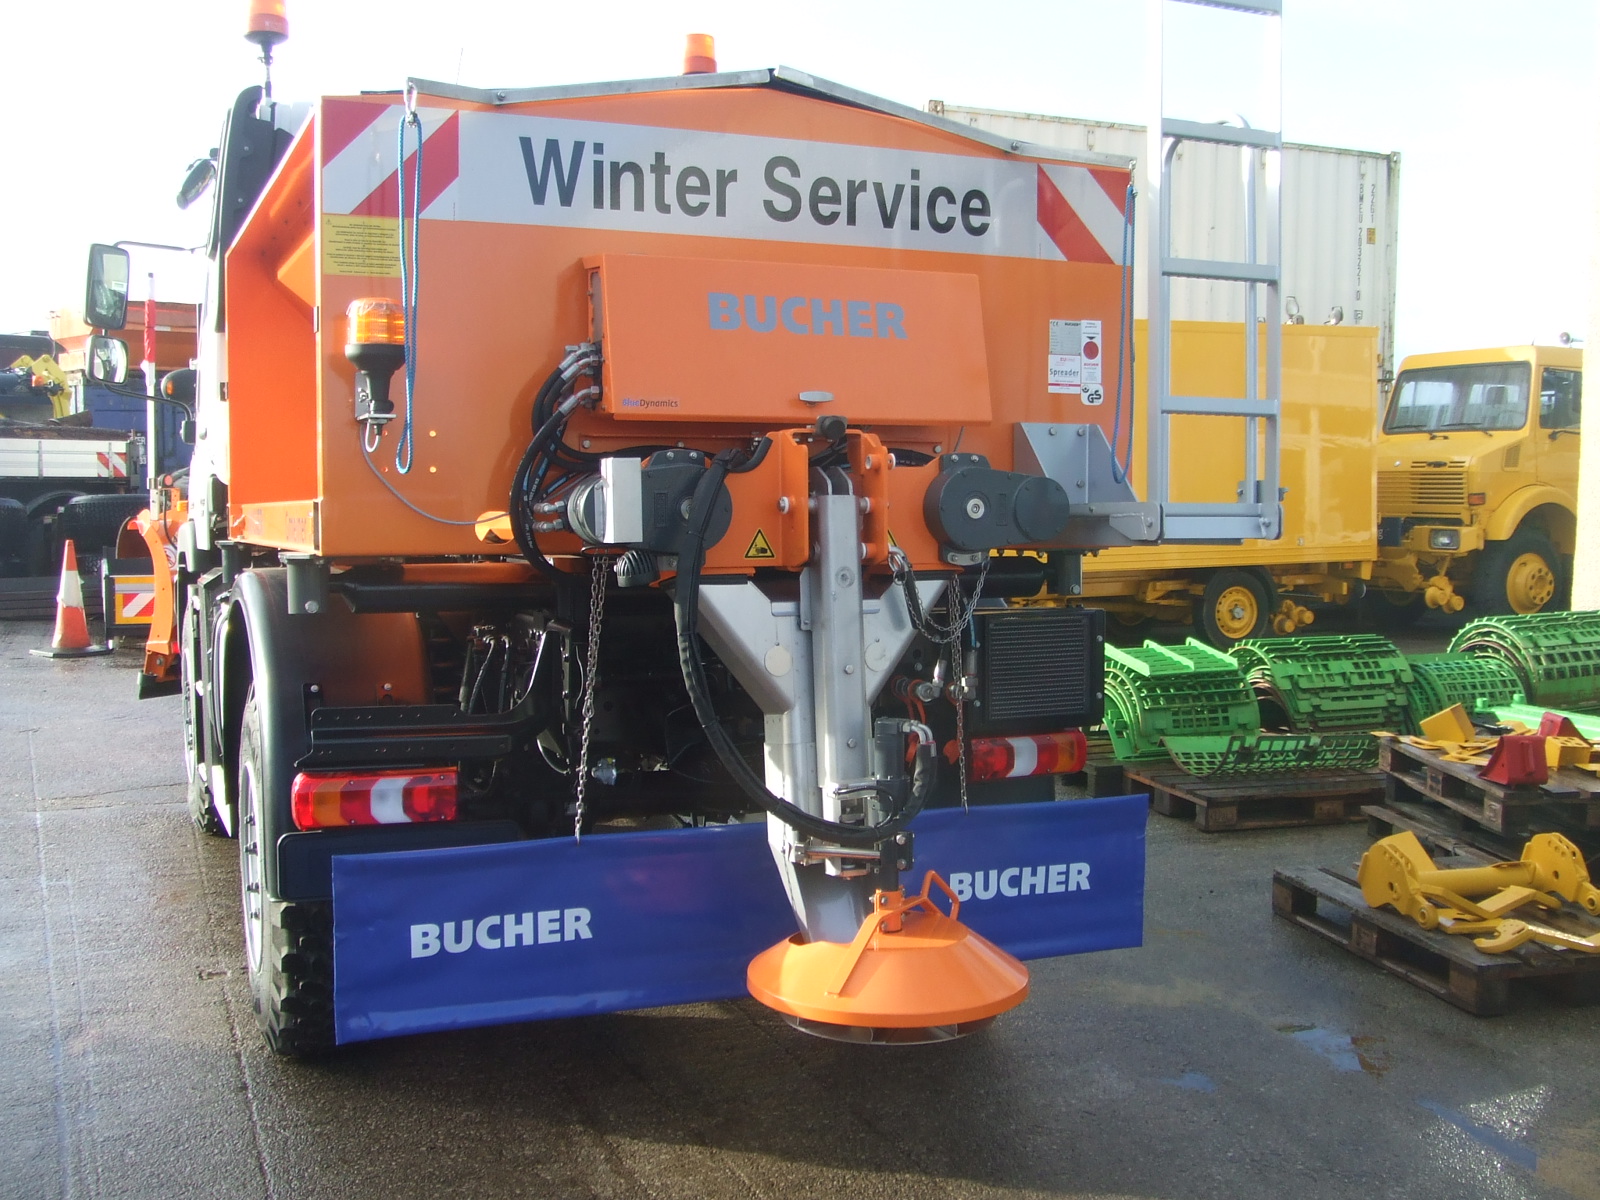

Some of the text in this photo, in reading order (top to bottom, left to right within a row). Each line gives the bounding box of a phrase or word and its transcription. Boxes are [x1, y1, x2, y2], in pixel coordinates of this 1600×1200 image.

[519, 136, 992, 237] Winter Service
[707, 292, 909, 340] BUCHER
[1049, 368, 1080, 377] Spreader
[622, 398, 679, 409] BlueDynamics
[1087, 389, 1102, 403] GS
[949, 862, 1091, 903] BUCHER
[410, 907, 593, 959] BUCHER
